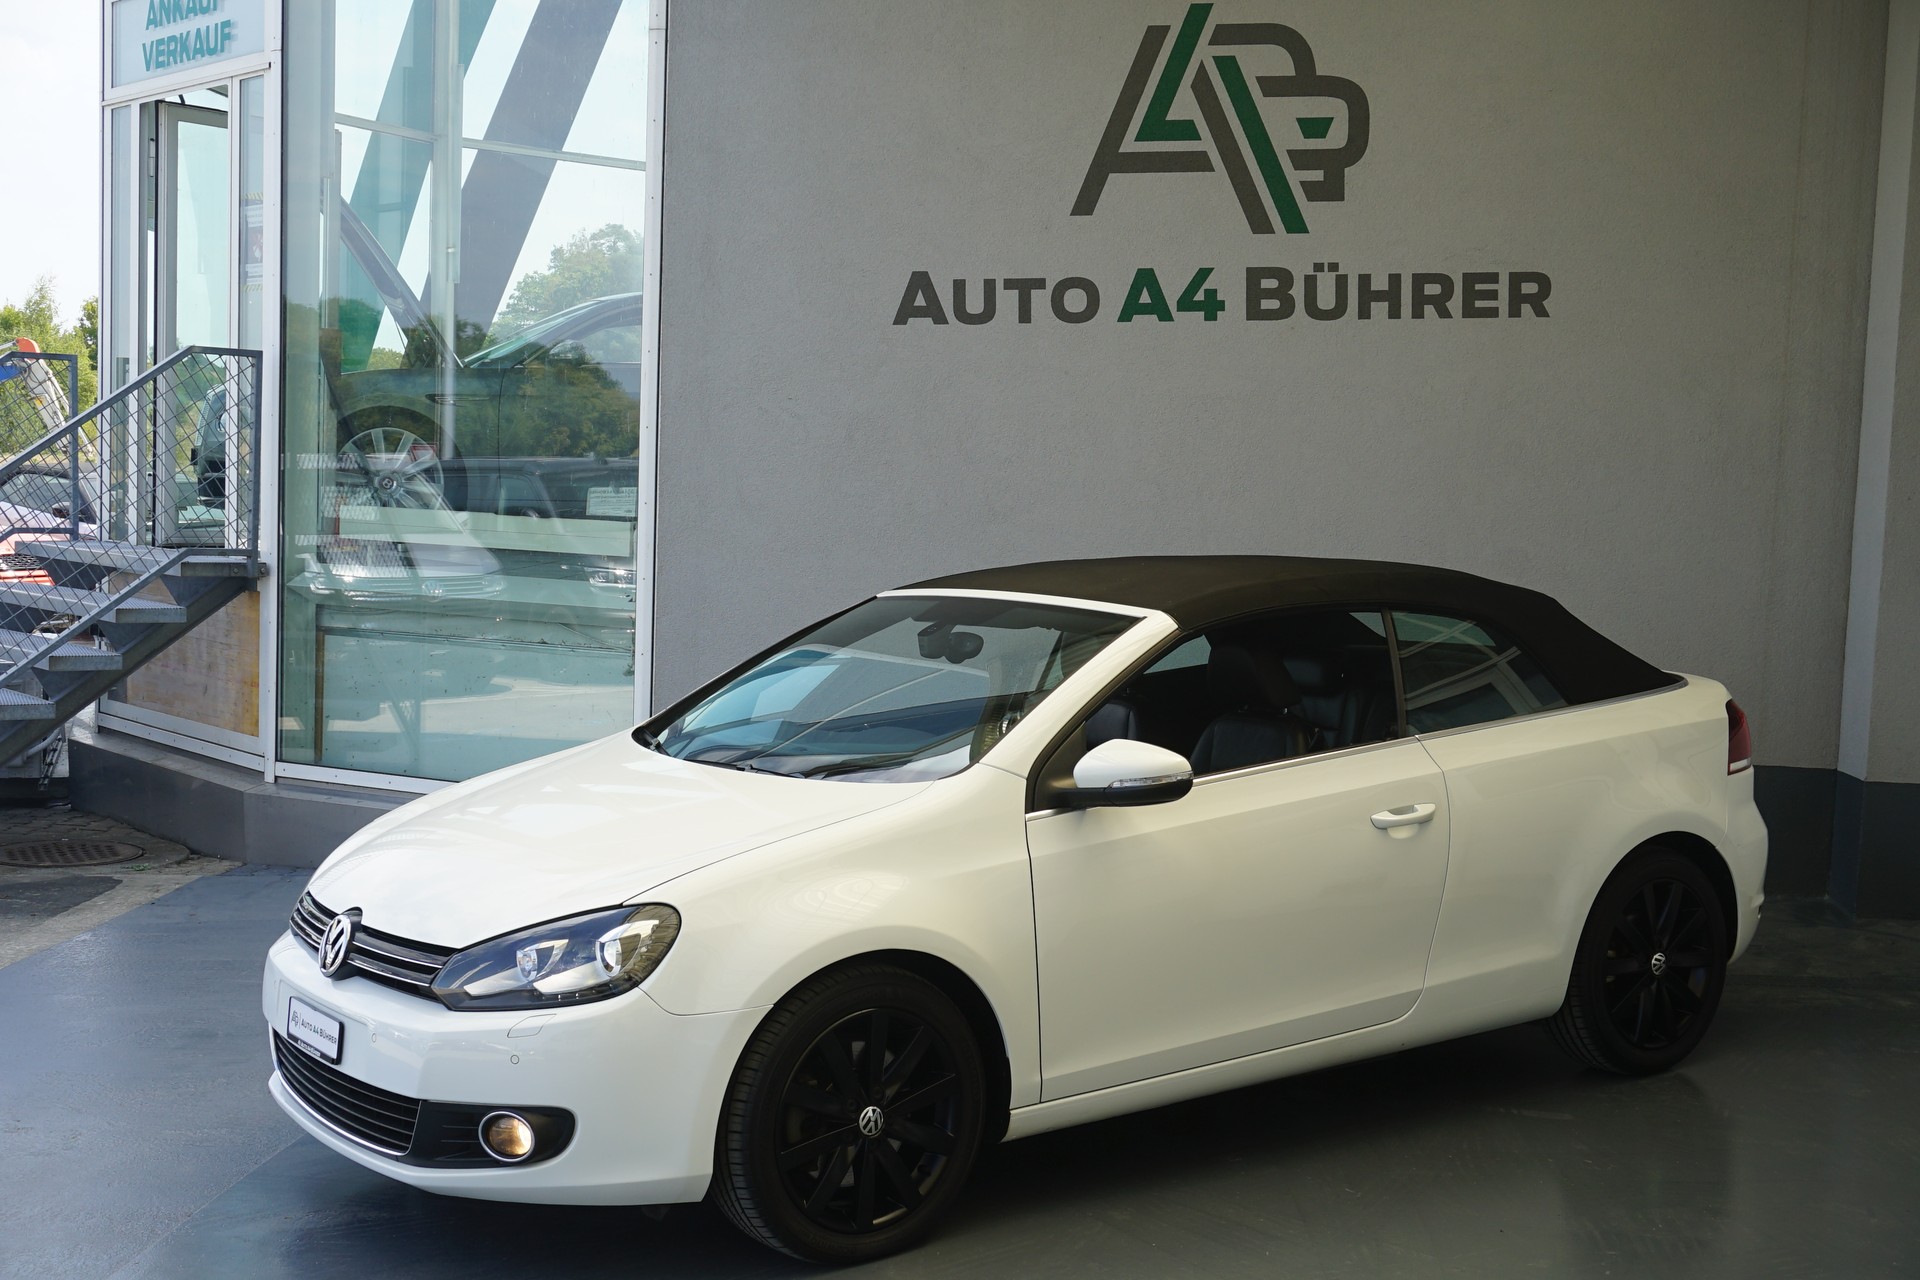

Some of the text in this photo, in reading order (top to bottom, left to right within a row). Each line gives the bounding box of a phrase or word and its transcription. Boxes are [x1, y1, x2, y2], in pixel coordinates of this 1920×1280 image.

[142, 19, 232, 72] VERKAUF
[892, 262, 1552, 326] AUTO A4 BÜHRER
